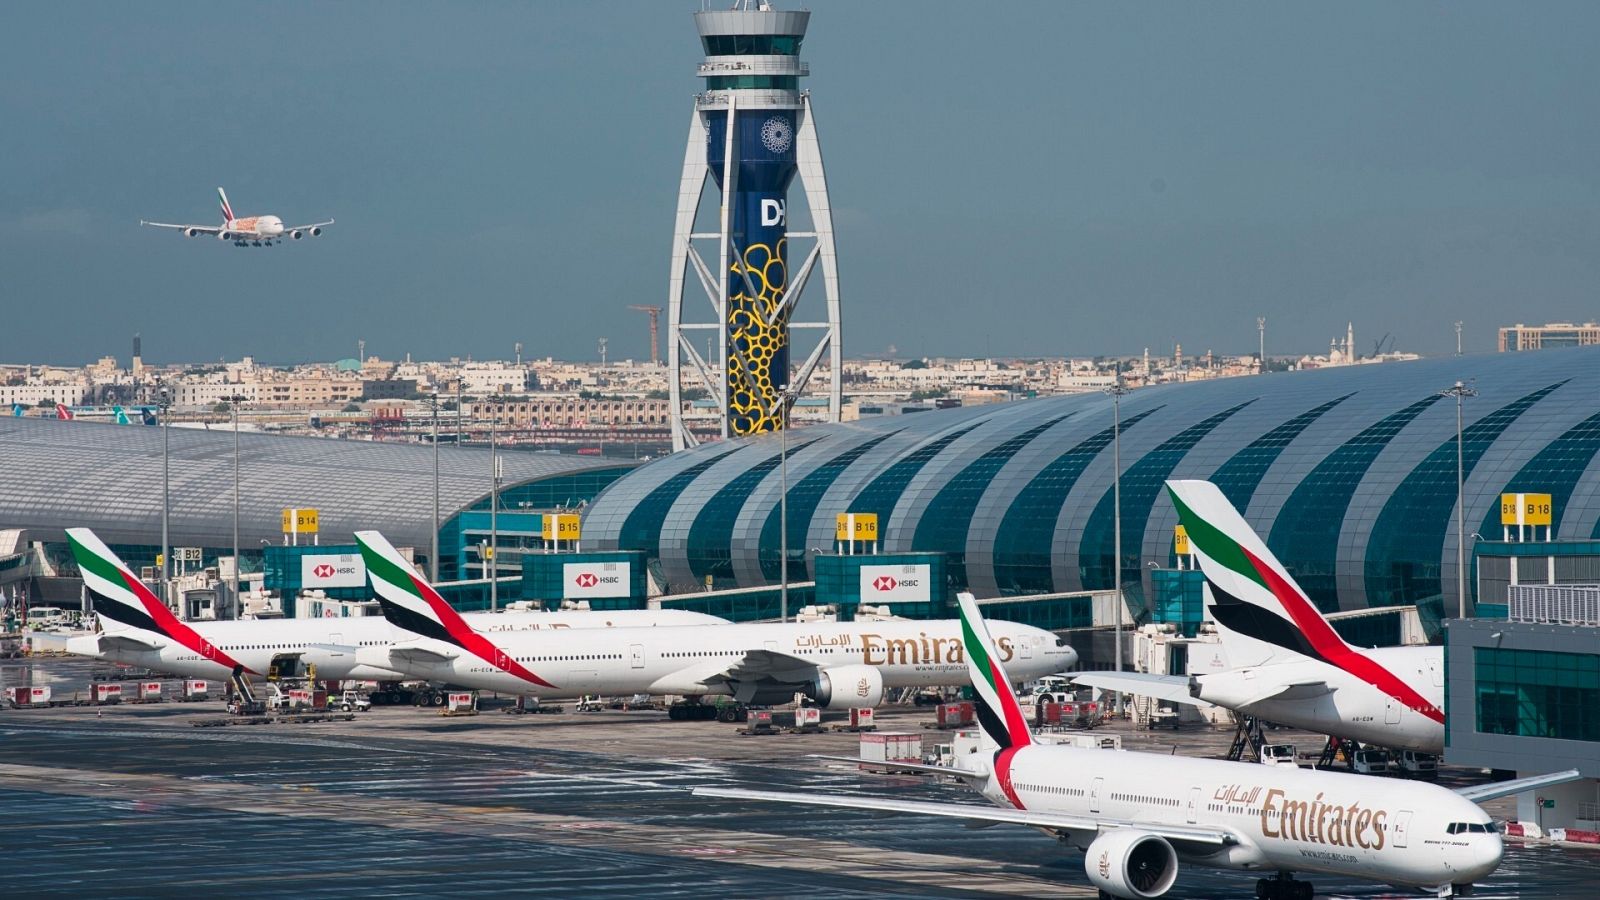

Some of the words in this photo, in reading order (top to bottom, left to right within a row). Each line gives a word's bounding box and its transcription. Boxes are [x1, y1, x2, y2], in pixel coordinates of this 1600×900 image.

[1527, 504, 1535, 514] B
[1537, 504, 1550, 514] 18
[298, 517, 305, 525] B
[306, 517, 316, 525] 14
[559, 523, 566, 531] B
[567, 523, 578, 531] 15
[855, 523, 862, 531] B
[865, 523, 875, 531] 16
[185, 550, 200, 559] B12
[859, 632, 1014, 666] Emiras
[1261, 788, 1387, 851] Emirates
